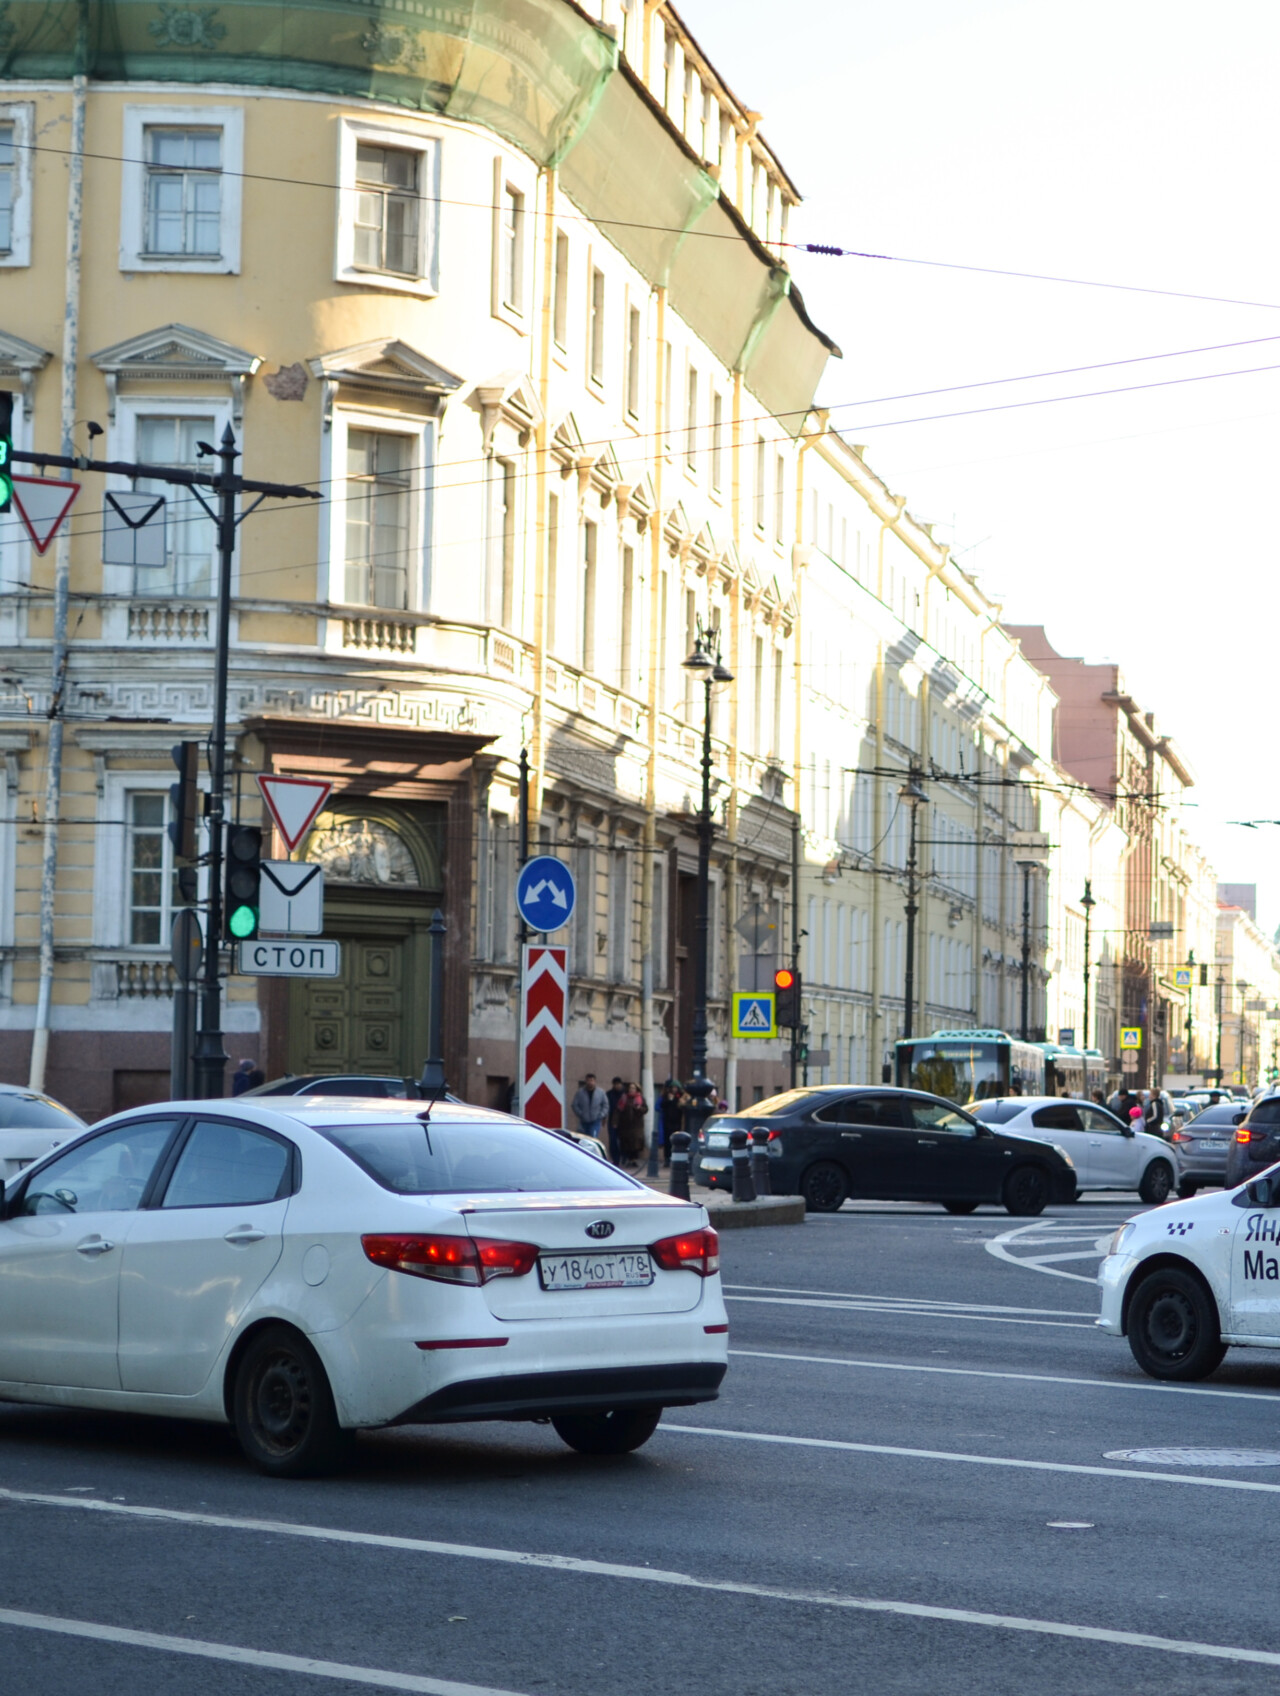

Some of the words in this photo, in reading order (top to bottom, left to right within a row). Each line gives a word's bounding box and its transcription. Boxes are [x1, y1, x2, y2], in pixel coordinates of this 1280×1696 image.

[254, 947, 324, 968] СТОП
[591, 1224, 612, 1236] KIA
[619, 1256, 646, 1272] 178
